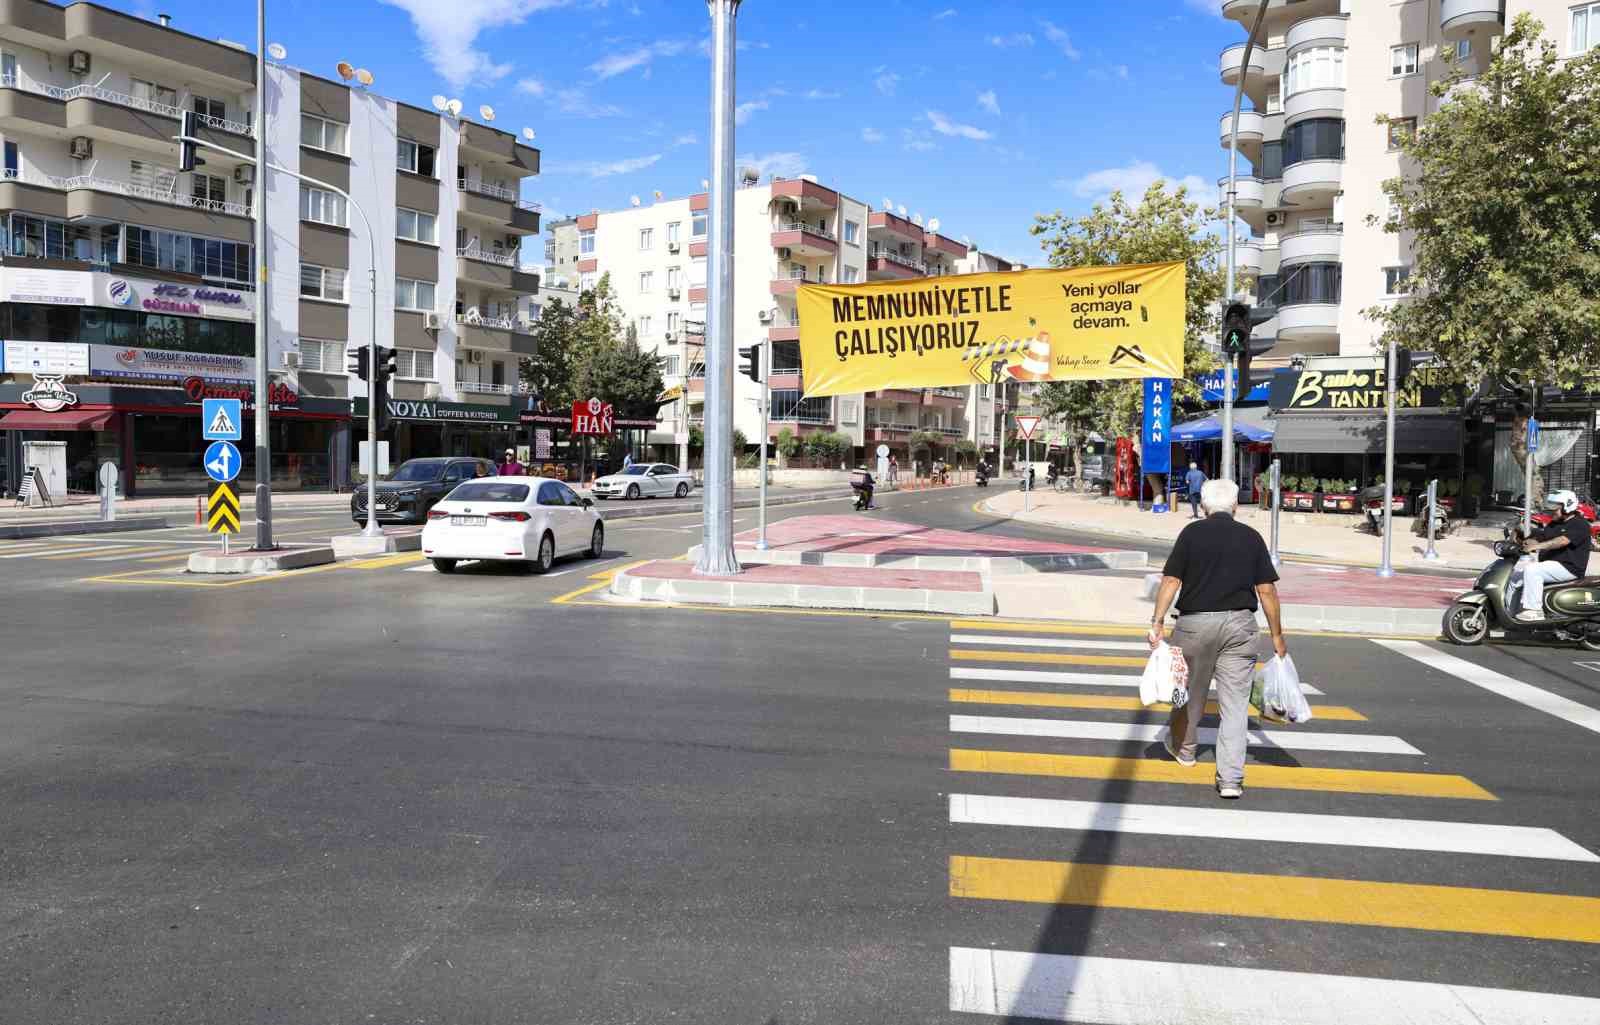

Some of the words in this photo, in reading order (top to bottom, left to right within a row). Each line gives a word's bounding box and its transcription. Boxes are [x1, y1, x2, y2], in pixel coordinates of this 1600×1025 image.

[1062, 283, 1094, 297] Yeni
[1098, 281, 1142, 298] yollar
[833, 285, 1012, 323] MEMNUNİYETLE
[1070, 299, 1132, 315] açmaya
[1073, 315, 1130, 329] devam.
[835, 321, 987, 361] ÇALIŞIYORUZ.
[387, 402, 432, 418] NOYA
[1152, 382, 1163, 442] HAKAN
[575, 414, 614, 433] HAN
